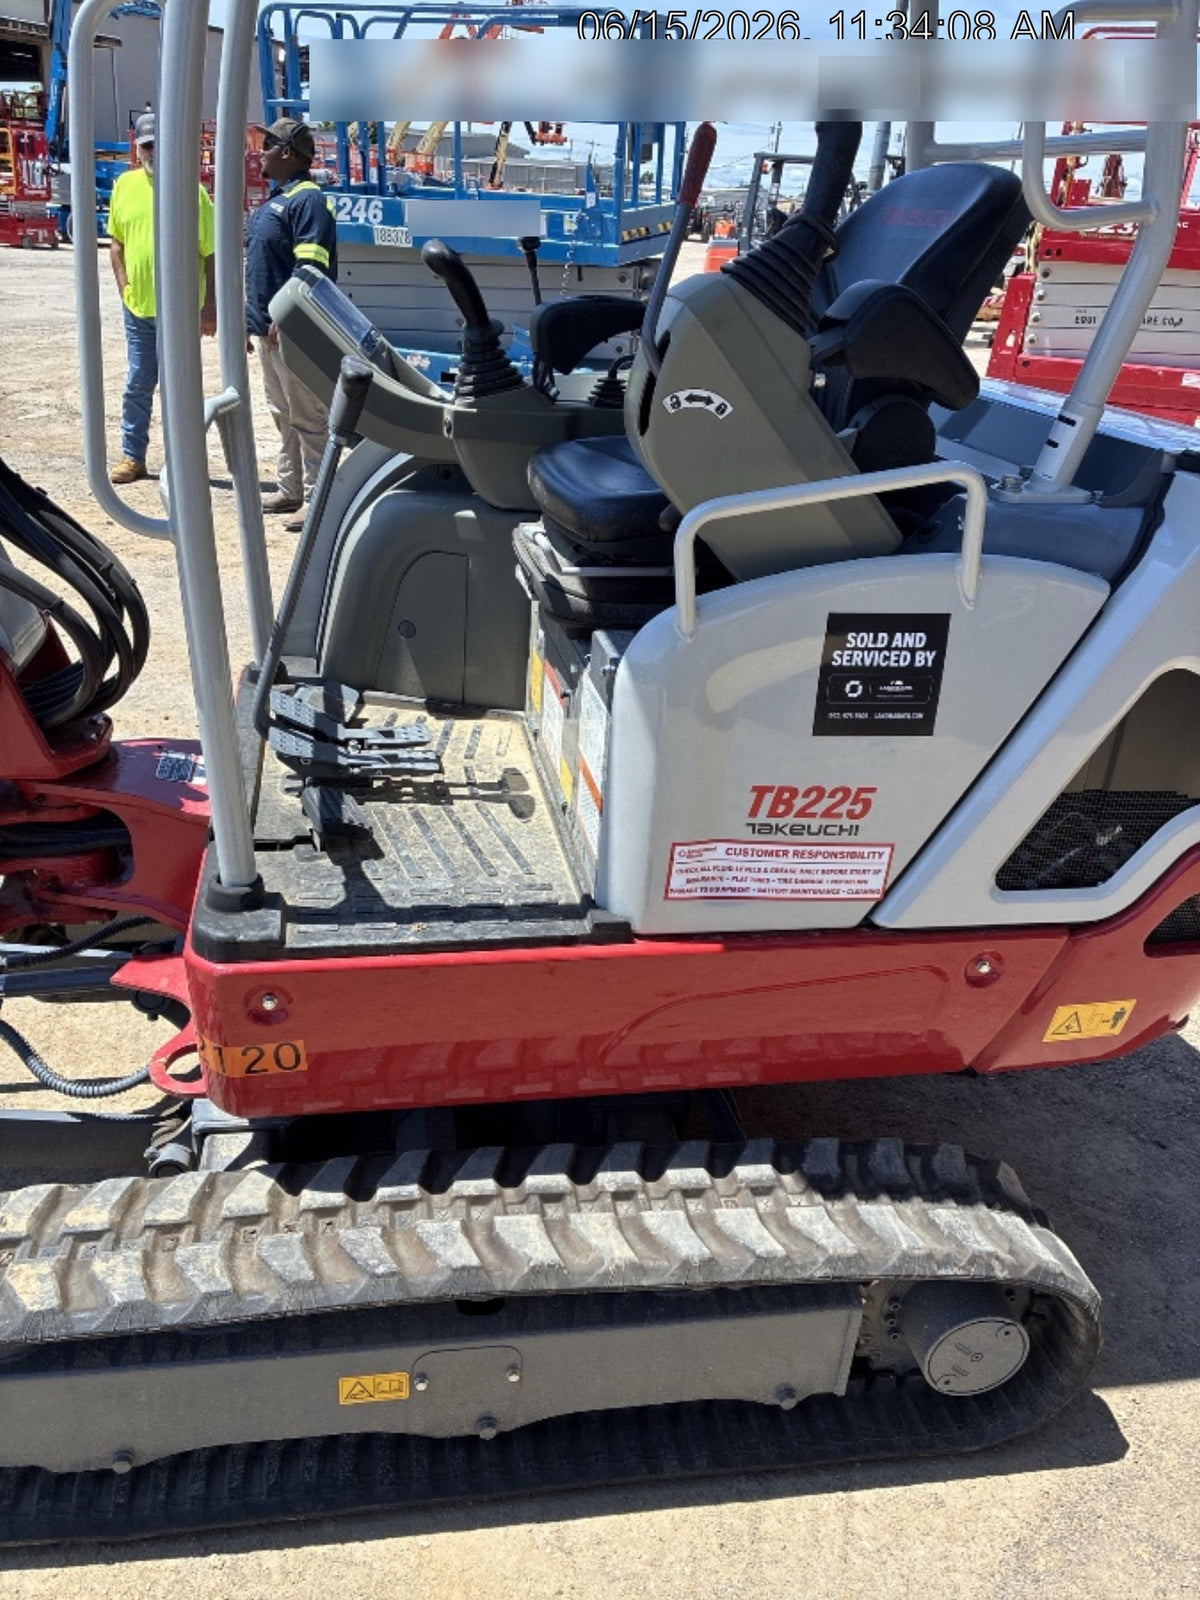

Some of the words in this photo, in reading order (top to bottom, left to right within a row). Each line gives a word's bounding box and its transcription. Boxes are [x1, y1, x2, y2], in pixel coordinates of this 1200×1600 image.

[846, 632, 889, 648] SOLD
[891, 632, 927, 648] AND
[831, 650, 911, 667] SERVICED
[914, 650, 937, 667] BY
[748, 785, 878, 820] TB225
[725, 847, 790, 859] CUSTOMER
[792, 849, 885, 860] RESPONSIBILITY
